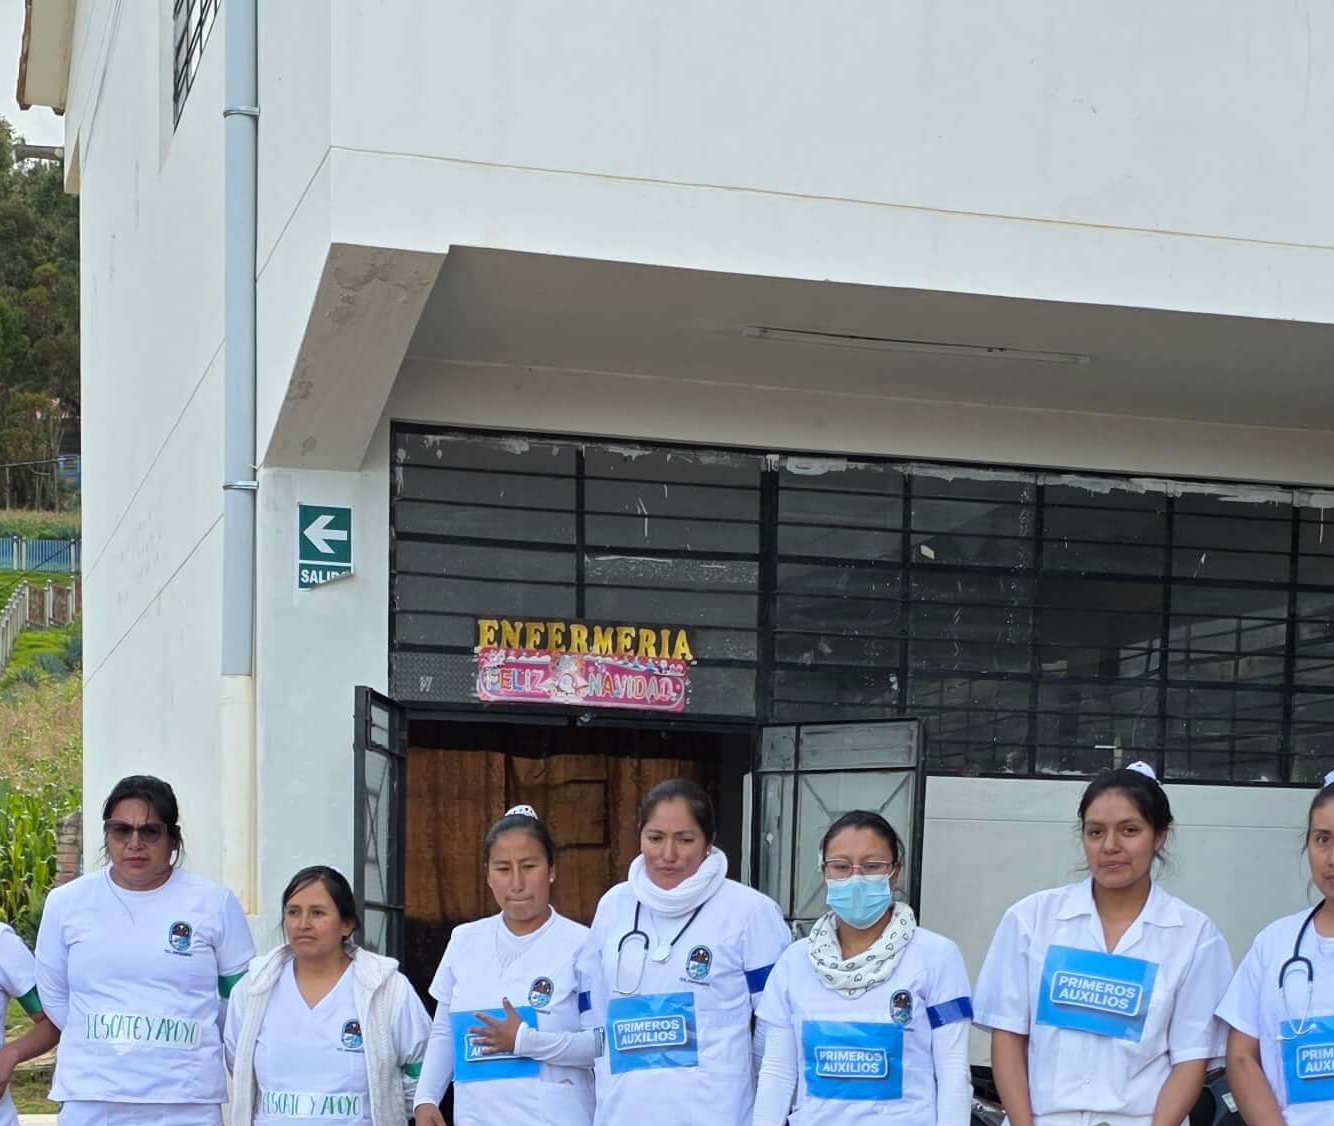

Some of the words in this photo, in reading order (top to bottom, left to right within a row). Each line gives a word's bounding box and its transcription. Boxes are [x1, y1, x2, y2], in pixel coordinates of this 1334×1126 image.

[477, 618, 694, 661] ENFERMERIA
[486, 667, 545, 694] FELIZ
[587, 671, 674, 703] NAVIDAD
[1058, 975, 1136, 999] PRIMEROS
[1058, 988, 1129, 1010] AUXILIOS
[617, 1019, 680, 1034] PRIMEROS
[620, 1030, 677, 1047] AUXILIOS
[819, 1050, 883, 1062] PRIMEROS
[822, 1061, 880, 1073] AUXILIOS
